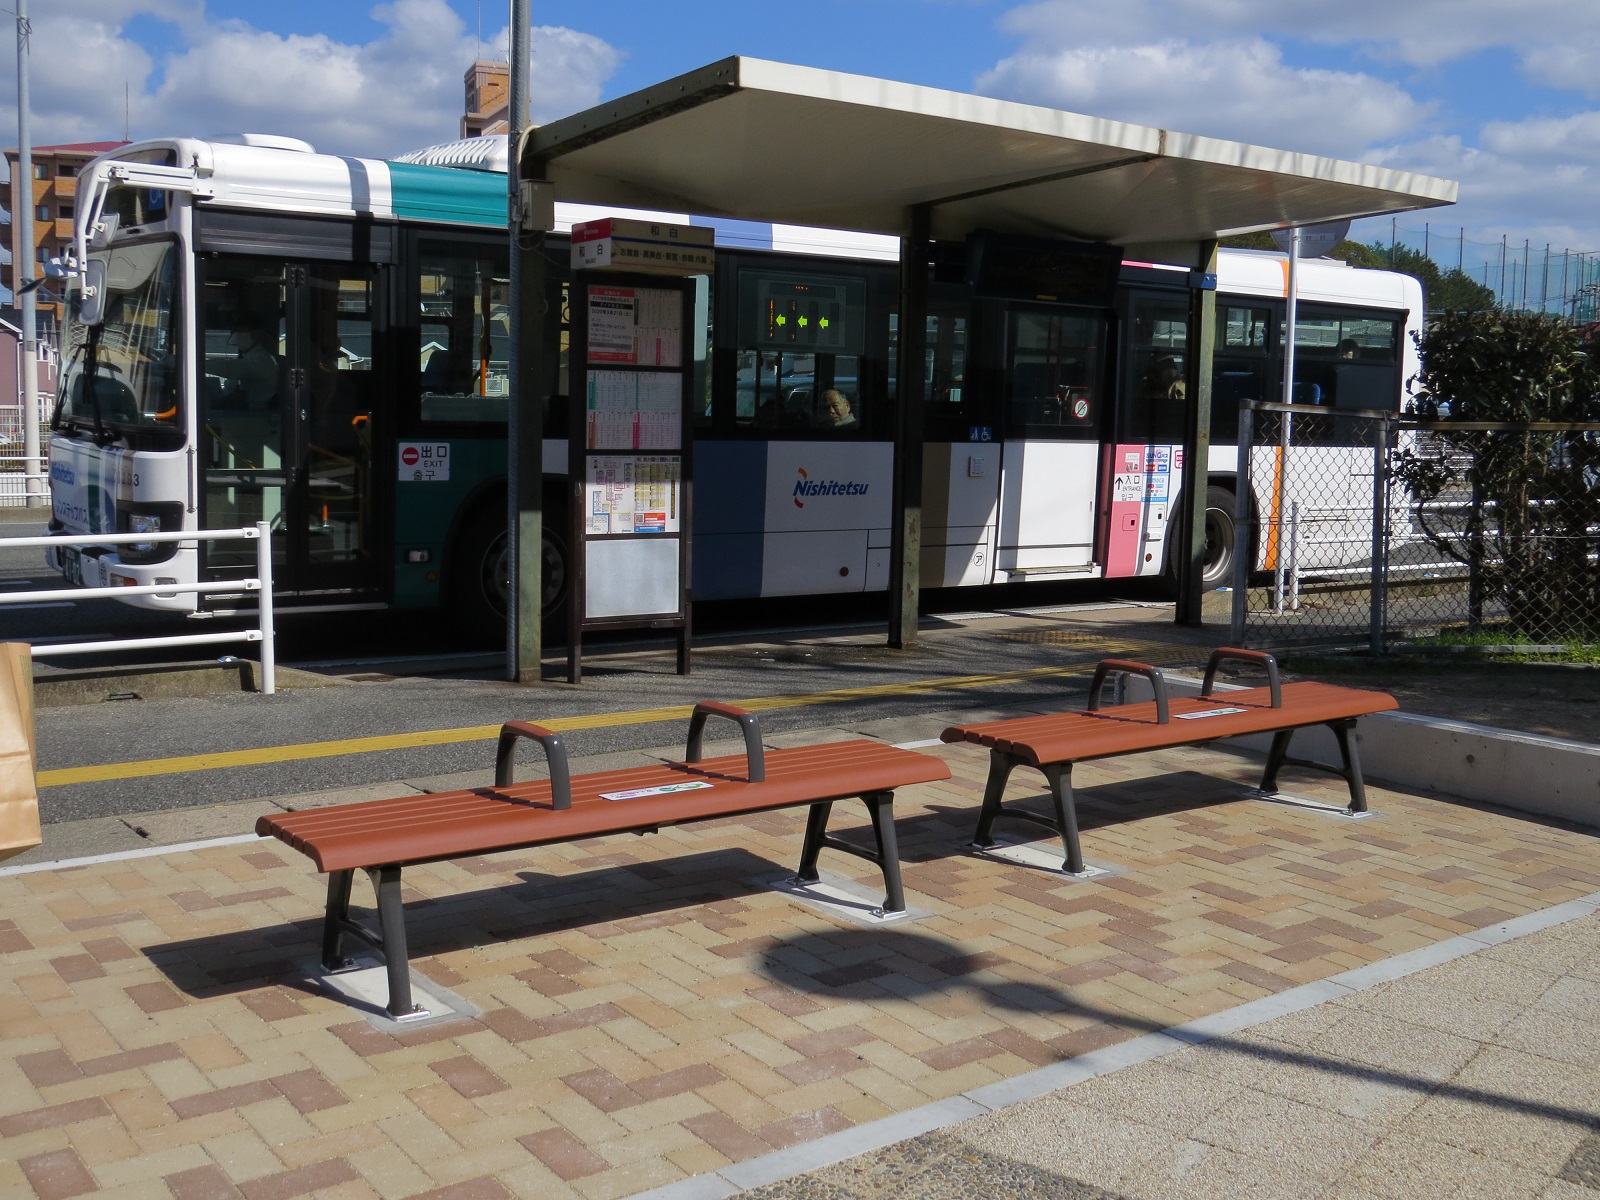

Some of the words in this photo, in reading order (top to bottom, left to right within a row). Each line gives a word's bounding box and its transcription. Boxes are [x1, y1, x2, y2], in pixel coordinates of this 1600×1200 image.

[651, 225, 678, 238] 和白
[578, 244, 603, 258] 和白
[421, 445, 447, 458] 出口
[424, 460, 443, 468] EXIT
[1125, 475, 1140, 485] 入口
[793, 480, 869, 496] Nishitetsu
[1121, 493, 1134, 502] 입구
